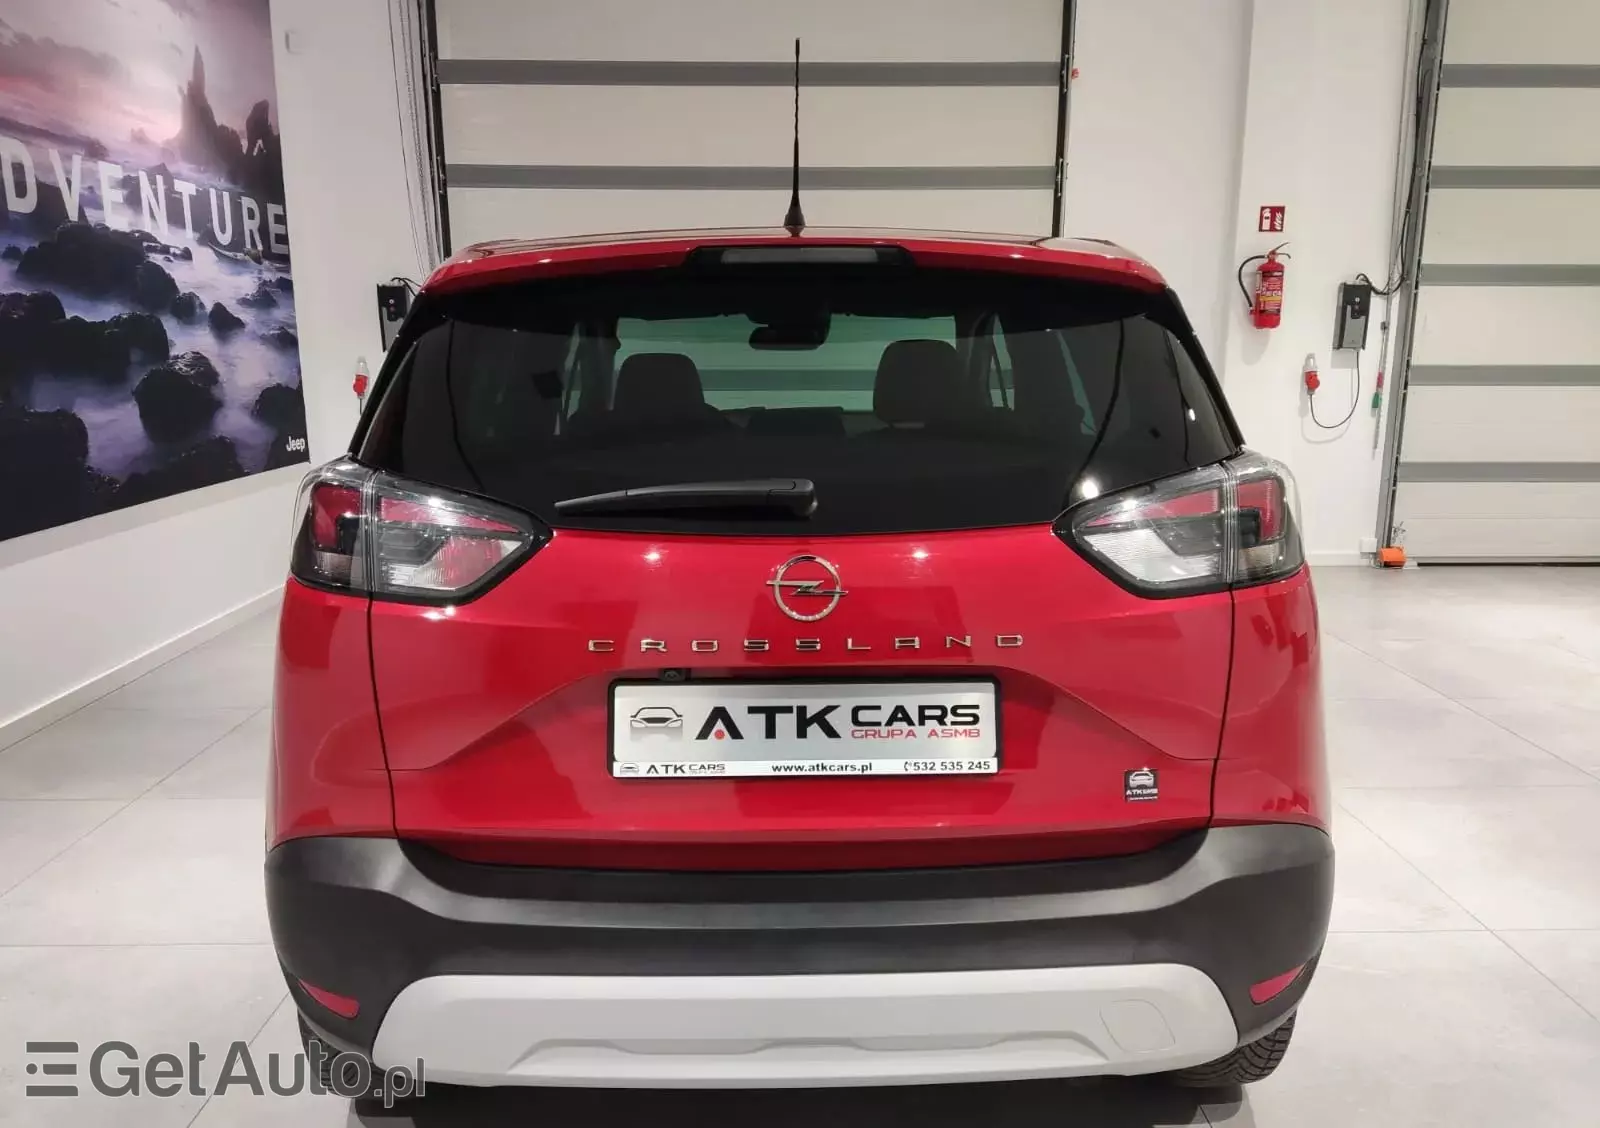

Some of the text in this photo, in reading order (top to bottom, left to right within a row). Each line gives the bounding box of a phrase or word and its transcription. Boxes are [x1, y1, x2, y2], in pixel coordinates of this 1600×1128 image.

[0, 135, 289, 255] DVENTURE
[286, 435, 306, 452] Jeep
[587, 633, 1025, 652] CROSSLAND
[695, 704, 980, 740] ATK CARS
[851, 728, 980, 739] GRUPA ASMB
[646, 764, 686, 775] ATK
[688, 763, 726, 771] CARS
[771, 762, 873, 773] www.atkcars.pl
[913, 761, 991, 771] 532 535 245
